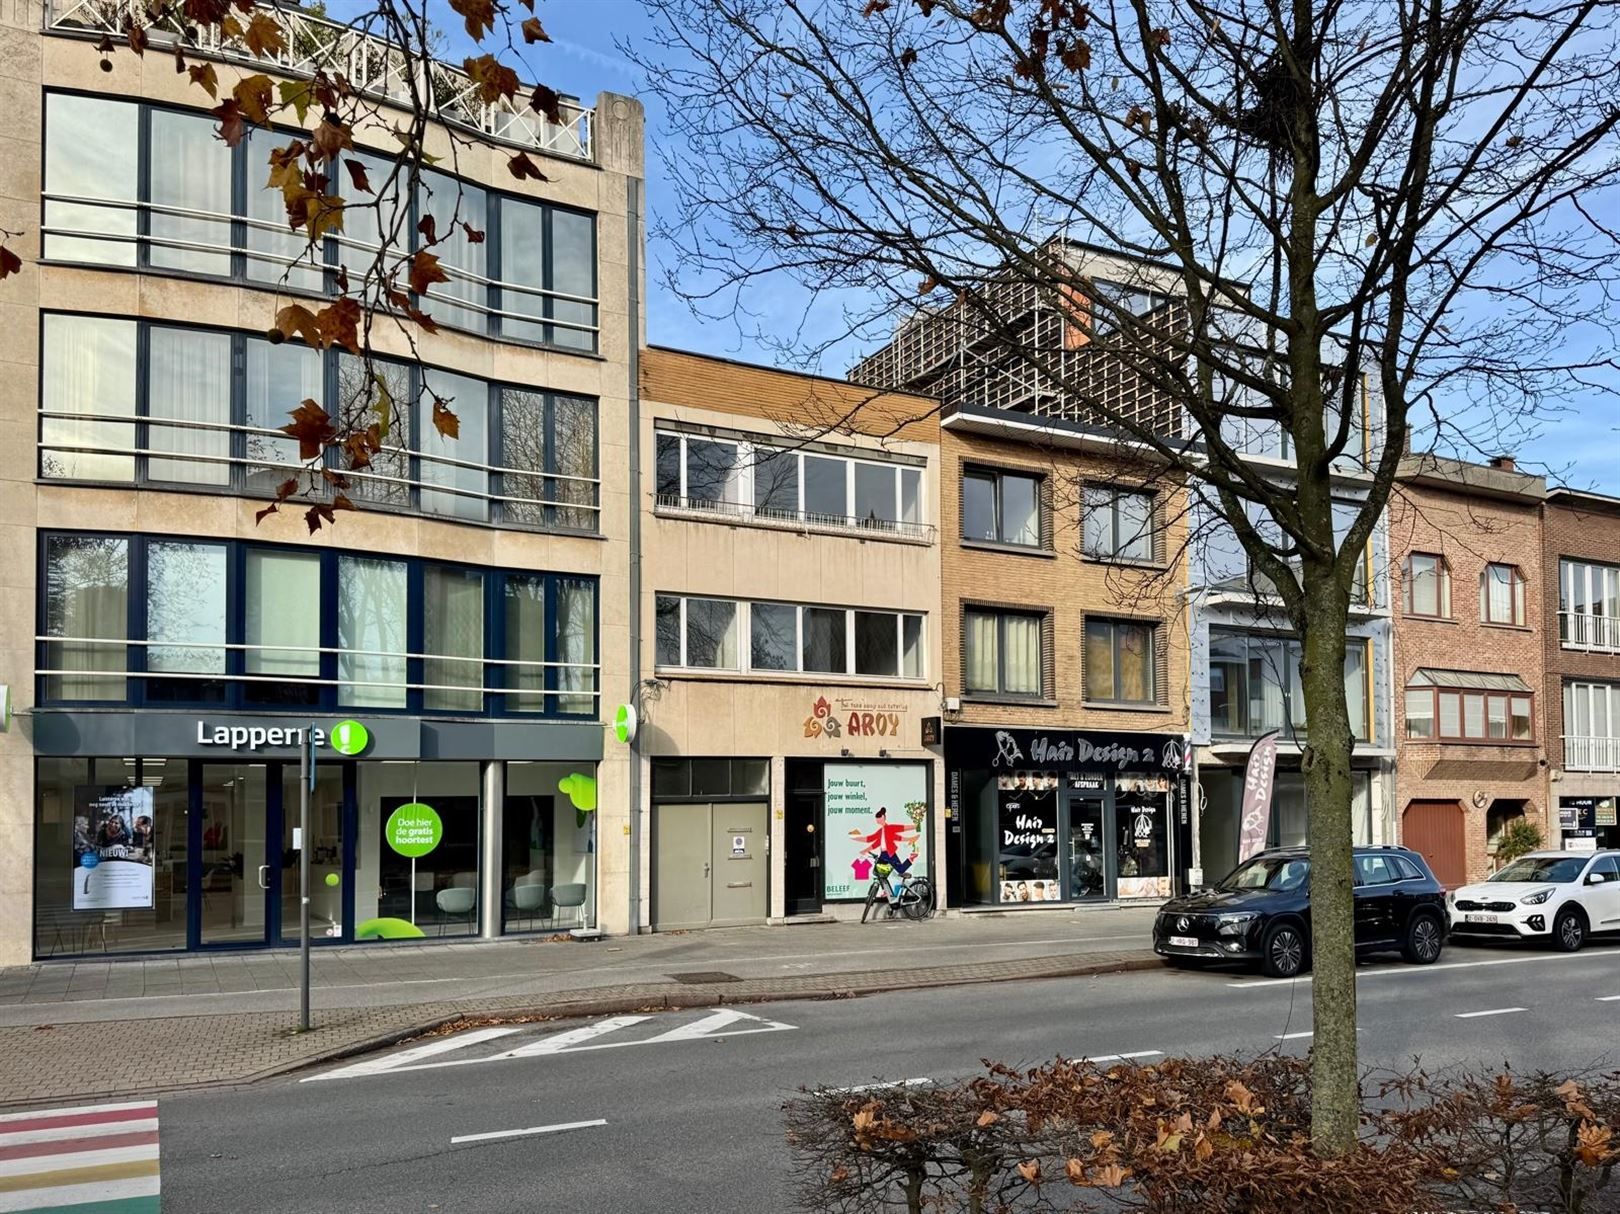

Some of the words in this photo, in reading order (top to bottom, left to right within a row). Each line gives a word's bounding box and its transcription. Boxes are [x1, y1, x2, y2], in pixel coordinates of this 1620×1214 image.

[848, 711, 900, 736] AROY
[1031, 737, 1074, 764] Hair
[1077, 738, 1140, 770] Design
[1142, 748, 1155, 762] 2
[951, 771, 959, 794] DAMES
[397, 818, 415, 827] Doe
[416, 817, 433, 827] hier
[1015, 814, 1043, 830] Hair
[396, 827, 407, 835] de
[408, 827, 434, 837] gratis
[396, 836, 434, 844] hoortest
[1004, 830, 1044, 849] Design
[1047, 834, 1055, 844] 2
[826, 884, 850, 893] BELEEF
